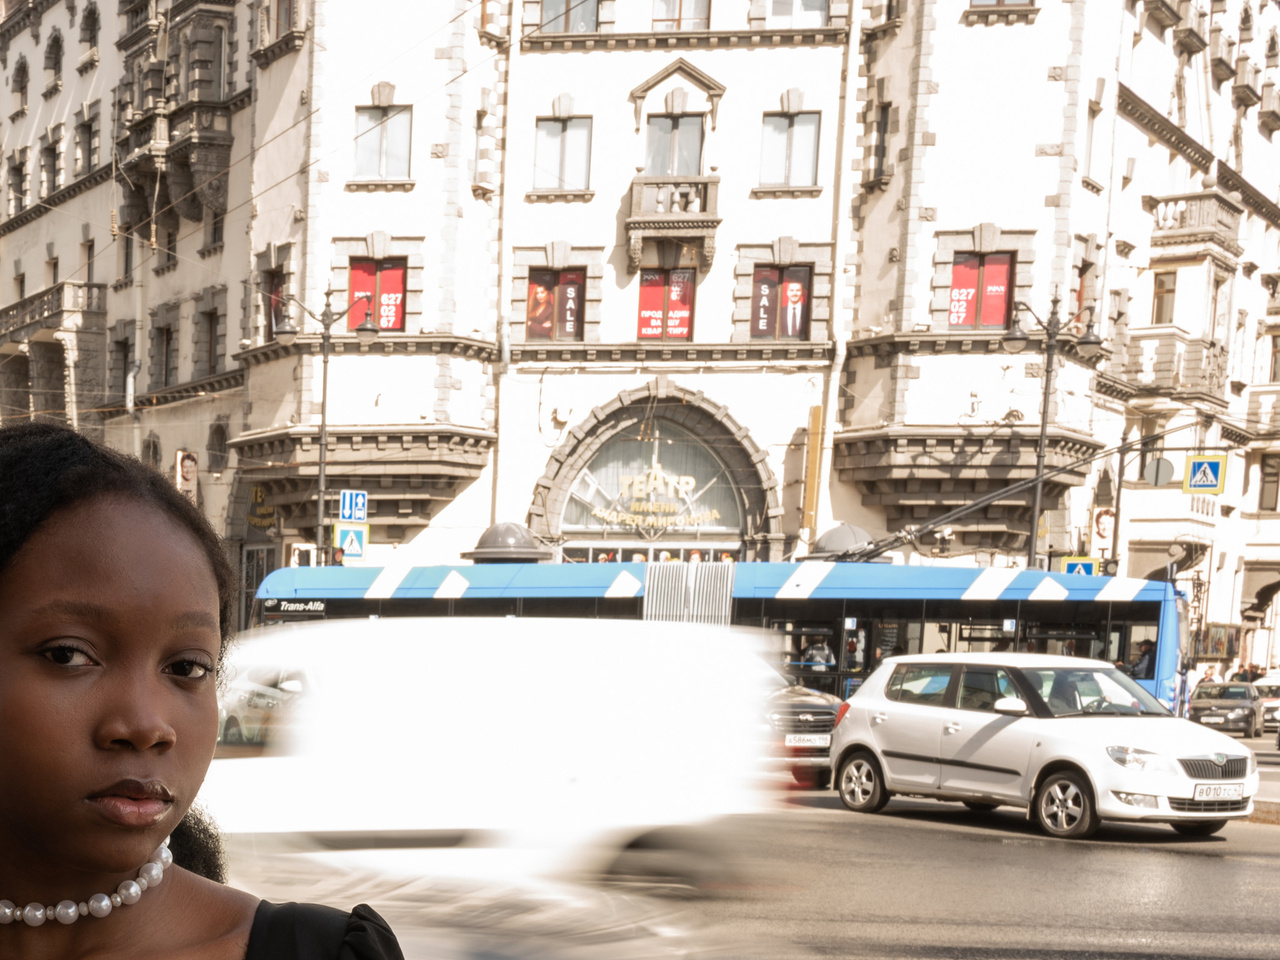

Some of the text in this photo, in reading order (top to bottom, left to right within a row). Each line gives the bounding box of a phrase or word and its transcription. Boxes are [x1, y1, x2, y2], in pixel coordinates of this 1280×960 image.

[381, 293, 402, 304] 627
[951, 288, 975, 300] 627
[380, 305, 396, 316] 02
[566, 287, 575, 332] SALE
[758, 285, 769, 330] SALE
[950, 301, 967, 312] 02
[380, 316, 395, 328] 67
[949, 312, 966, 324] 67
[620, 463, 696, 498] ТЕАТР
[630, 502, 679, 513] ИМЕНИ
[280, 601, 325, 611] Trans-Alfa
